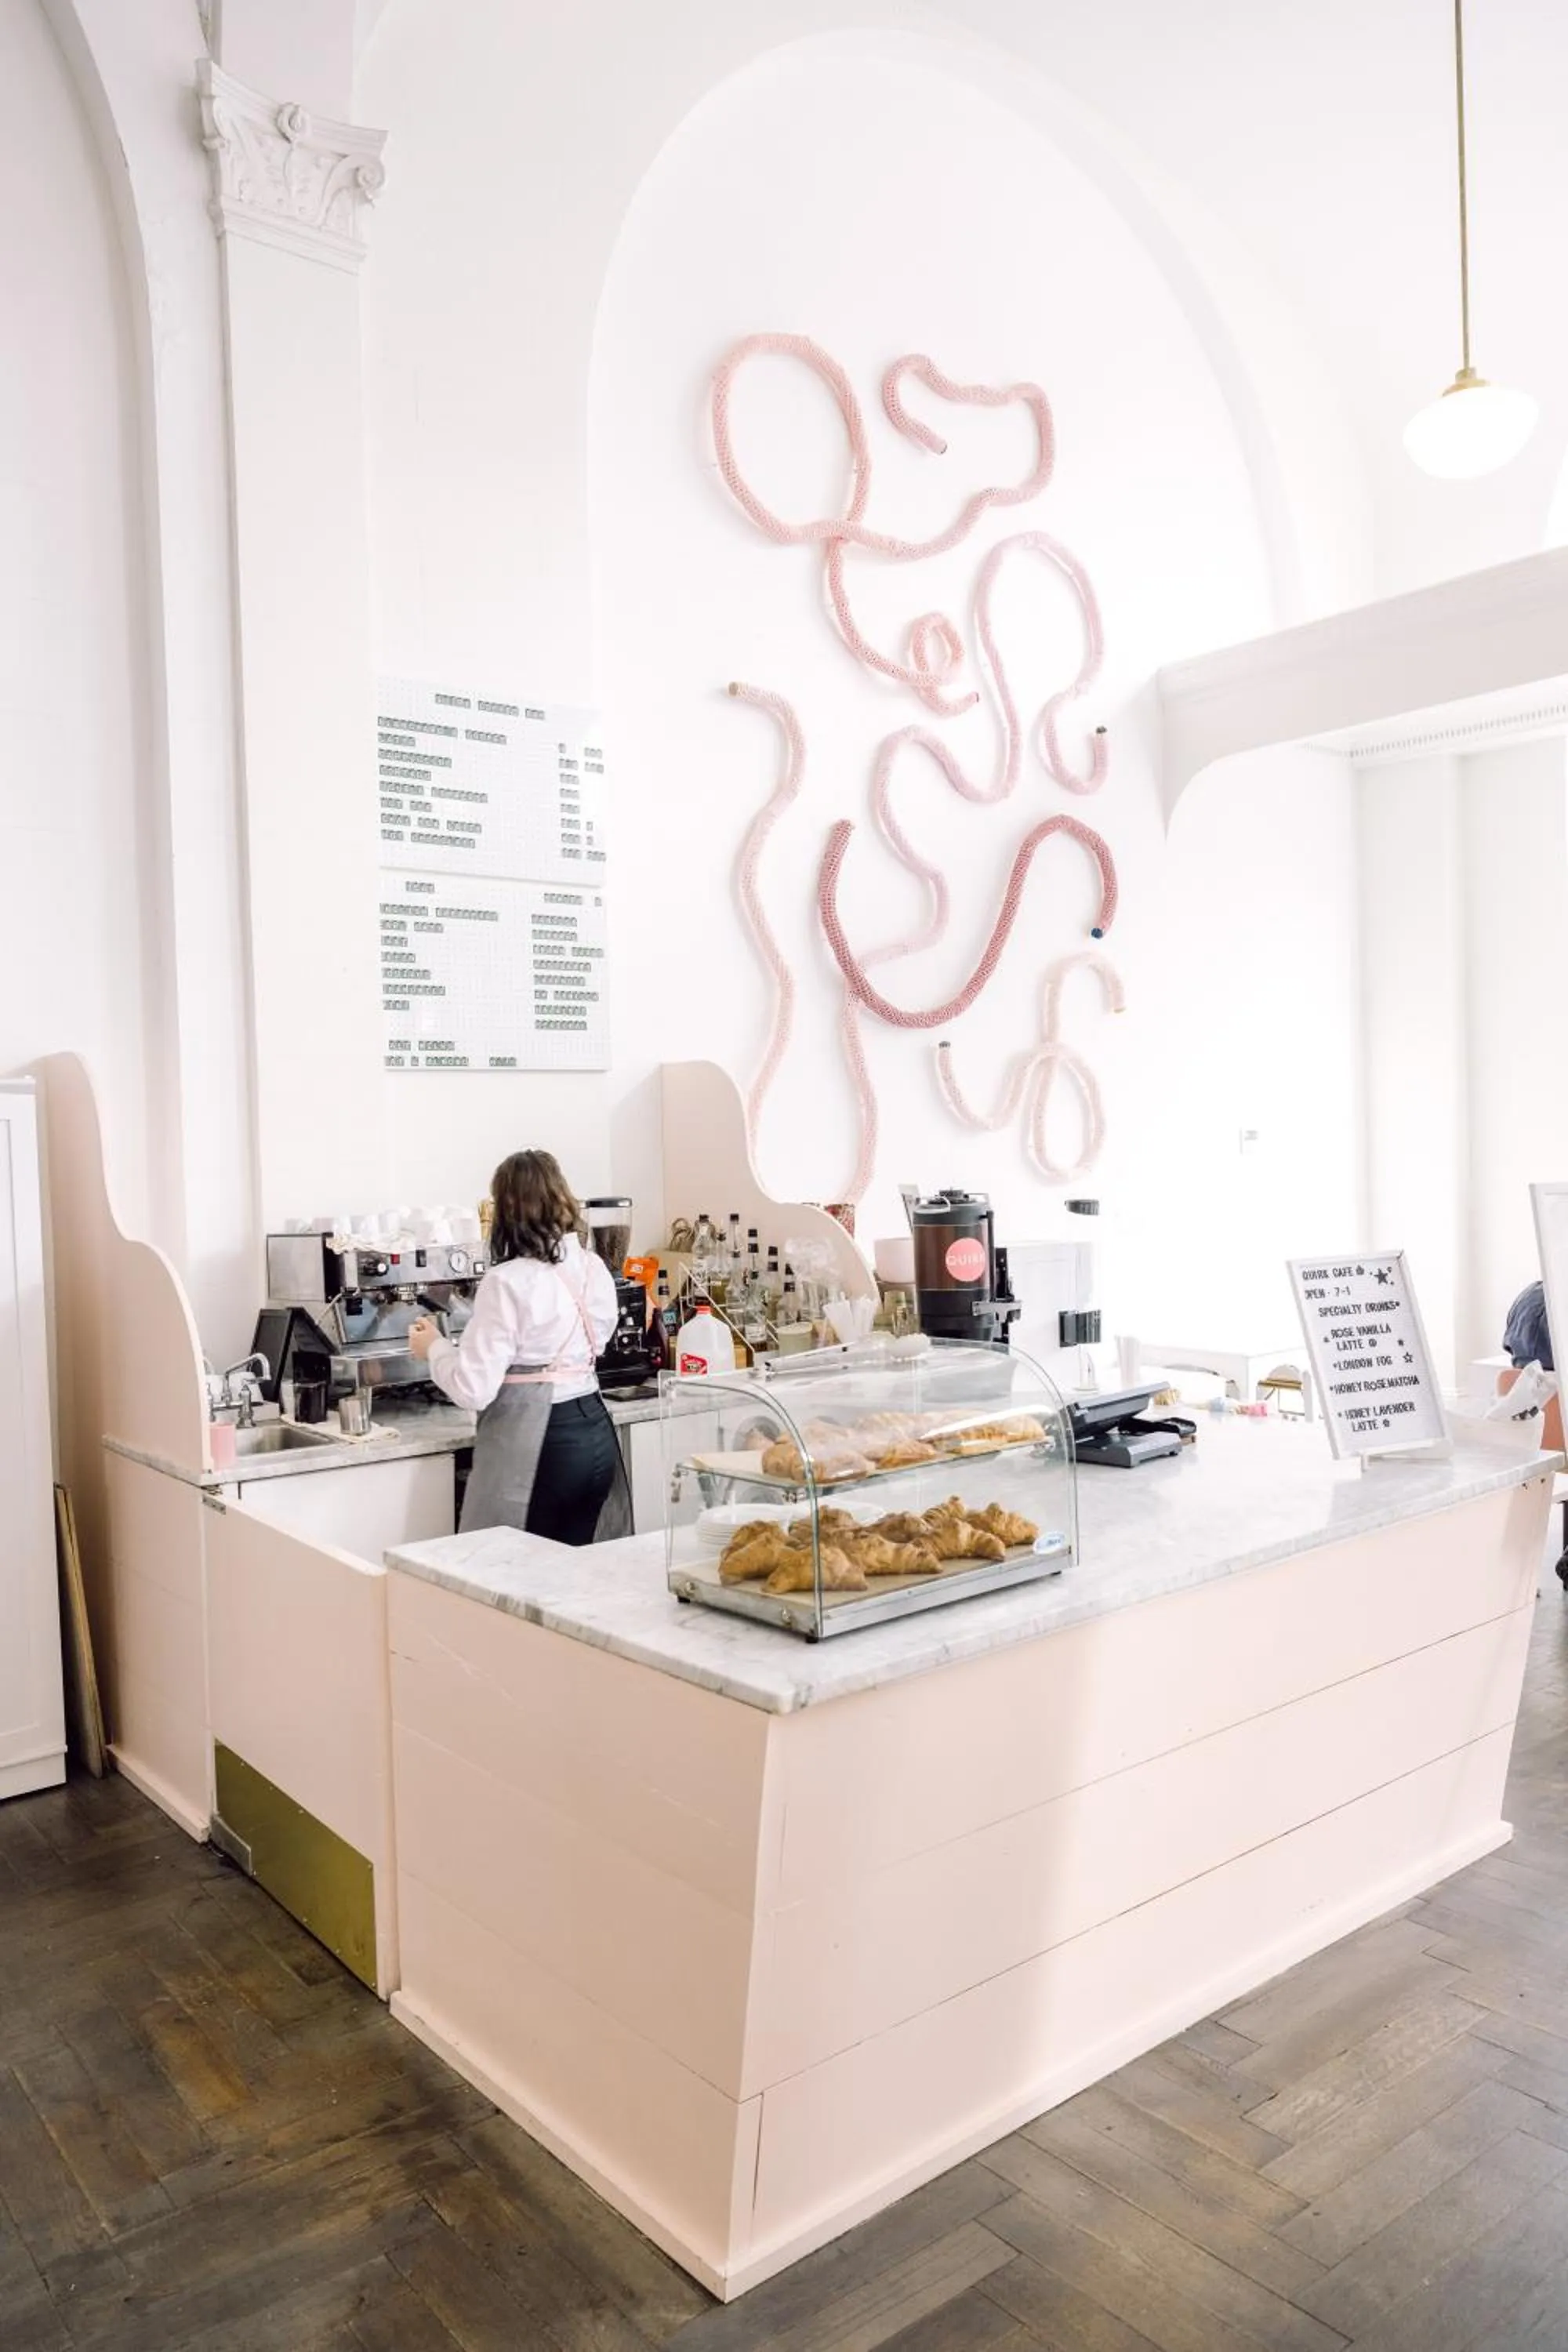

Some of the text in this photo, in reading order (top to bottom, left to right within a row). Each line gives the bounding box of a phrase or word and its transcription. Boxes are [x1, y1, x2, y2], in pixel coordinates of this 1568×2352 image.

[1332, 1267, 1354, 1278] CAFE
[1318, 1301, 1396, 1317] SPECIALTY DRINKS
[1330, 1323, 1392, 1338] ROSE VANILLA
[1336, 1339, 1364, 1351] LATTE
[1338, 1356, 1392, 1370] LONDON FOG
[1334, 1375, 1420, 1394] HONEY ROSE MATCHA
[1345, 1401, 1416, 1420] HONEY LAVENDER
[1351, 1418, 1378, 1432] LATTE
